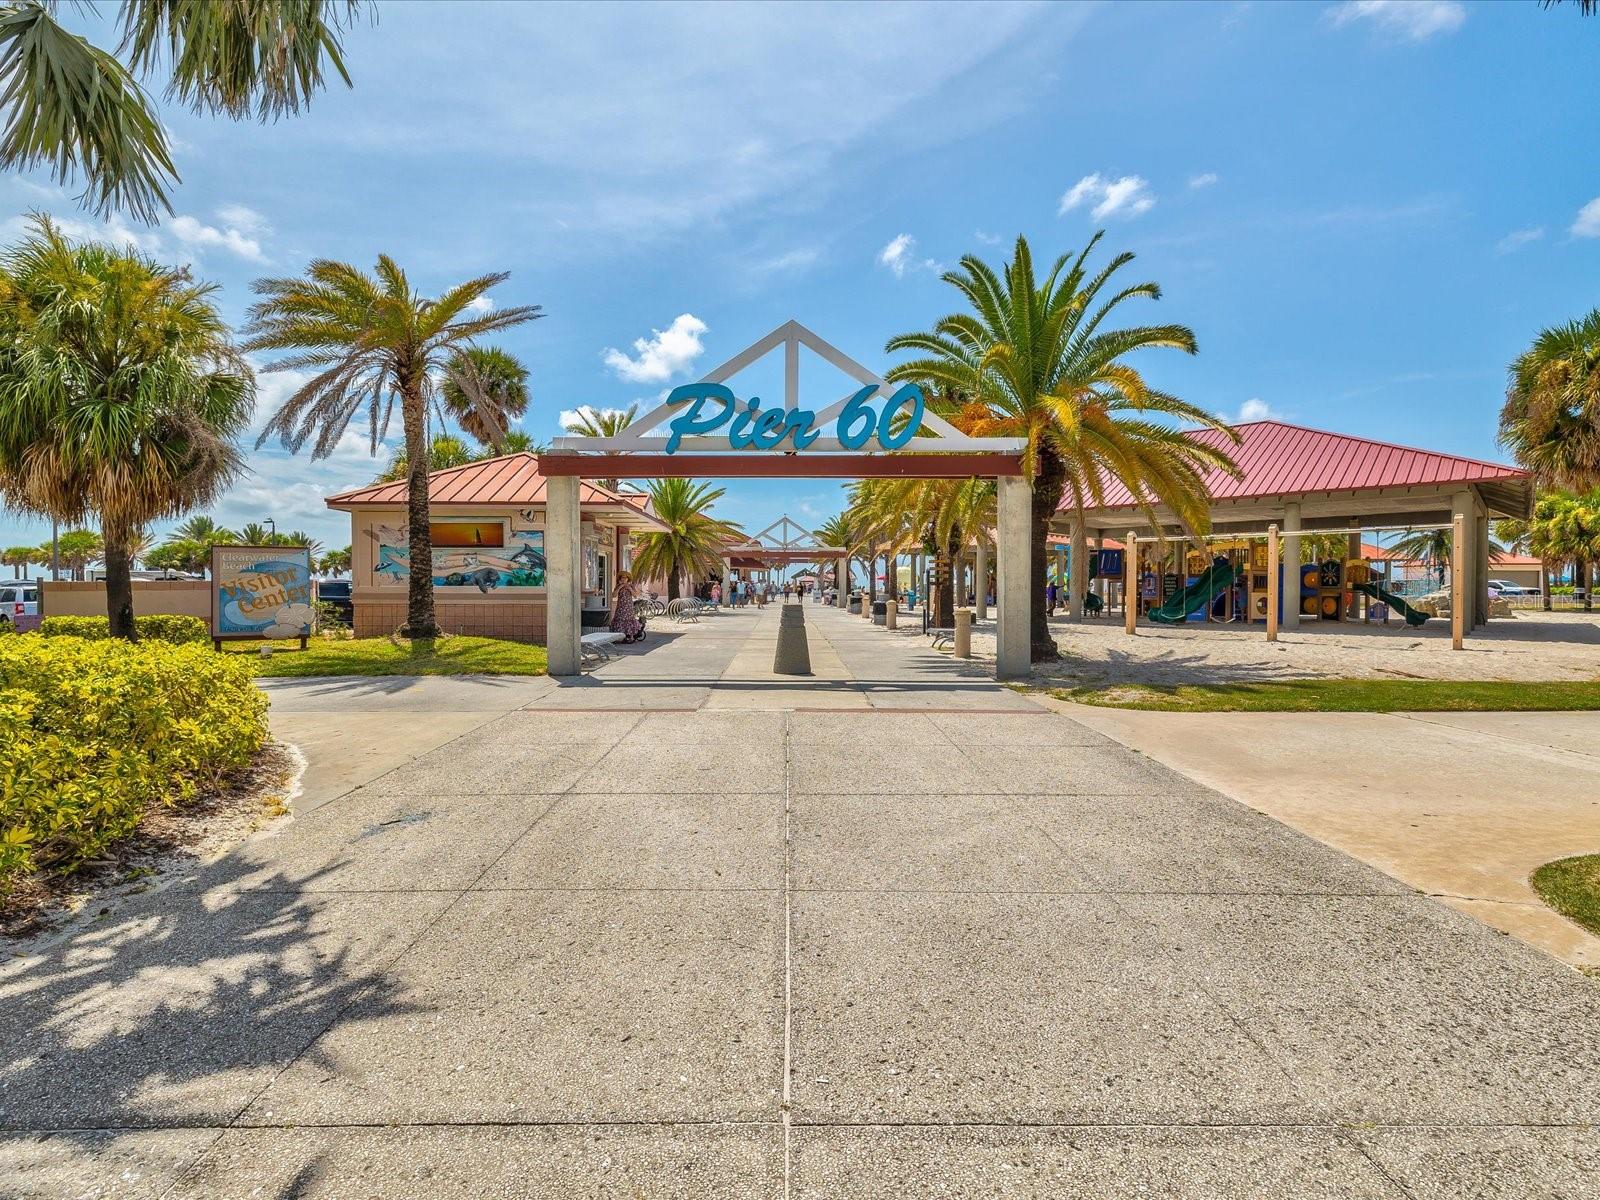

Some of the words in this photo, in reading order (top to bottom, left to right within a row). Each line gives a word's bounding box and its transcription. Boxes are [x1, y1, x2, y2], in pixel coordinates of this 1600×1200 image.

[666, 383, 820, 454] Pier
[837, 383, 925, 450] 60
[222, 552, 279, 562] Clearwater
[222, 561, 255, 570] Beach
[220, 567, 297, 597] Visitor
